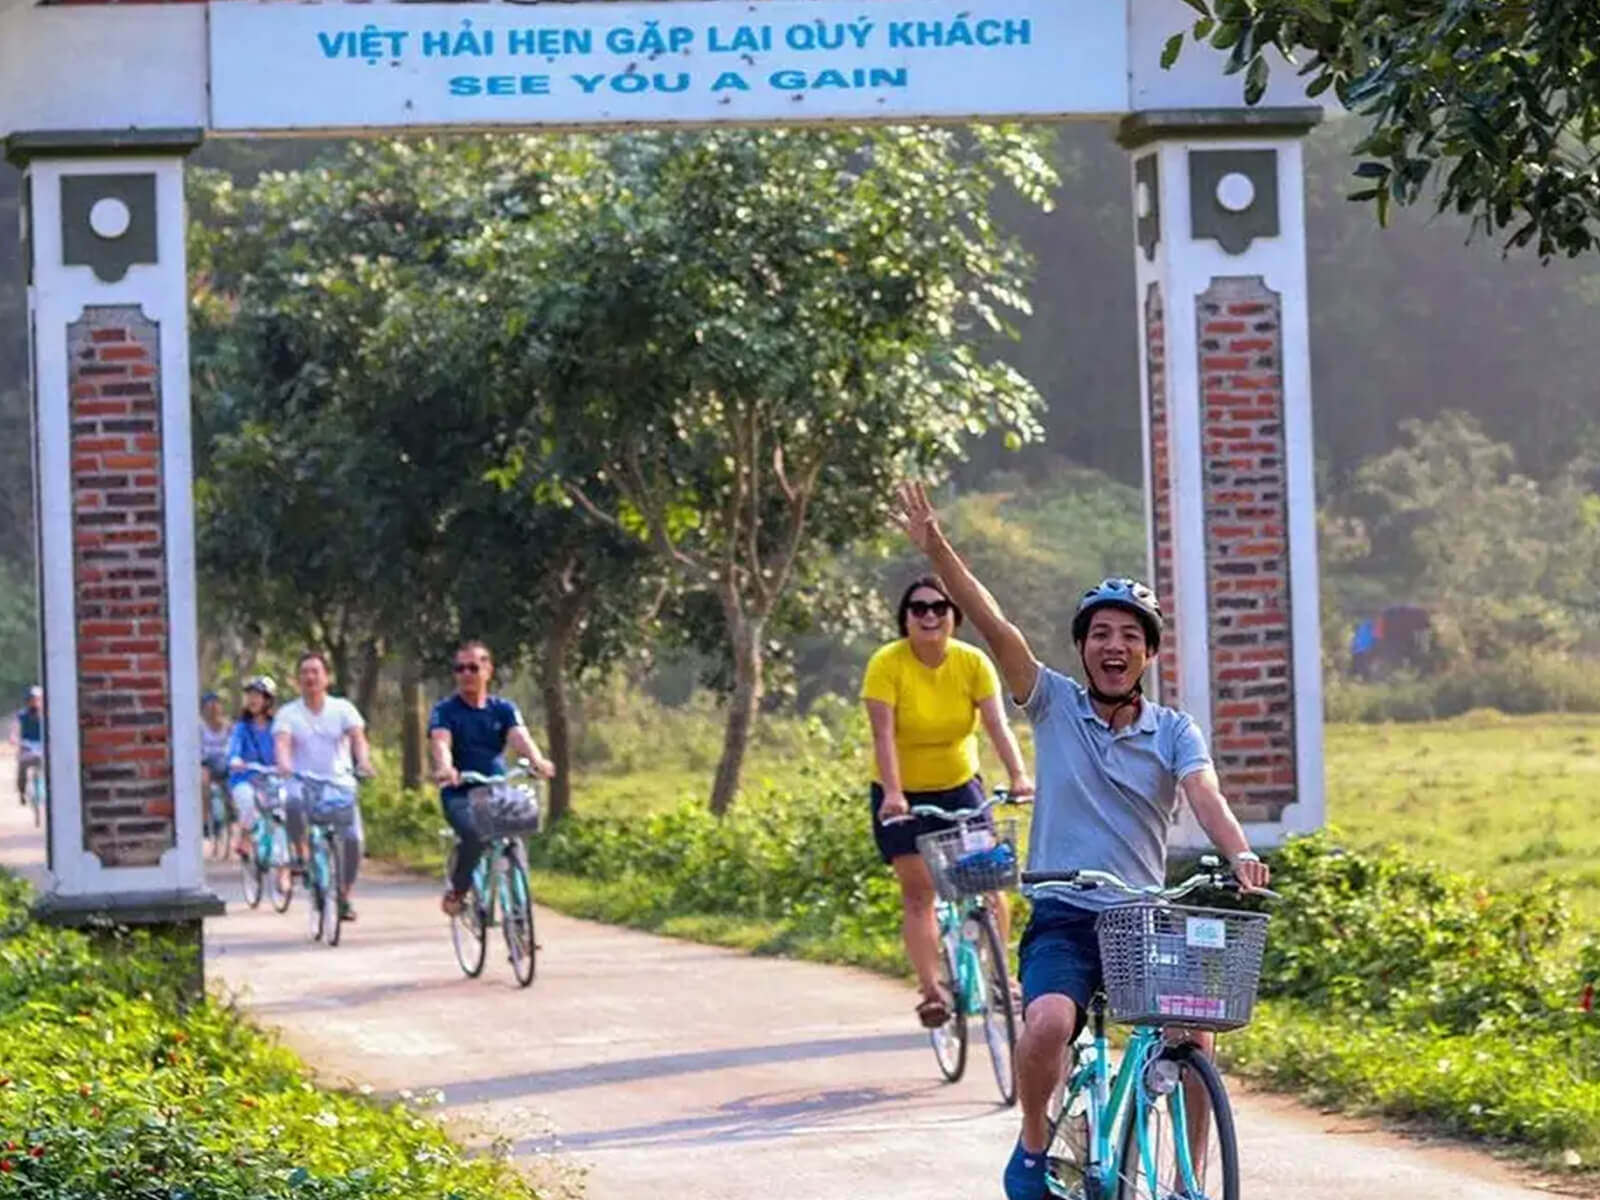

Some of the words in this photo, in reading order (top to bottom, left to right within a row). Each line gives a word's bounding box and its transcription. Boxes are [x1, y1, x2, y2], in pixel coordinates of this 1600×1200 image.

[317, 24, 408, 65] VIỆT
[422, 19, 494, 57] HẢI
[508, 28, 592, 62] HẸN
[605, 20, 695, 61] GẶP
[785, 16, 875, 51] QUÝ
[888, 11, 1031, 48] KHÁCH
[448, 75, 550, 96] SEE
[570, 72, 691, 94] YOU
[710, 71, 750, 92] A
[768, 67, 908, 90] GAIN
